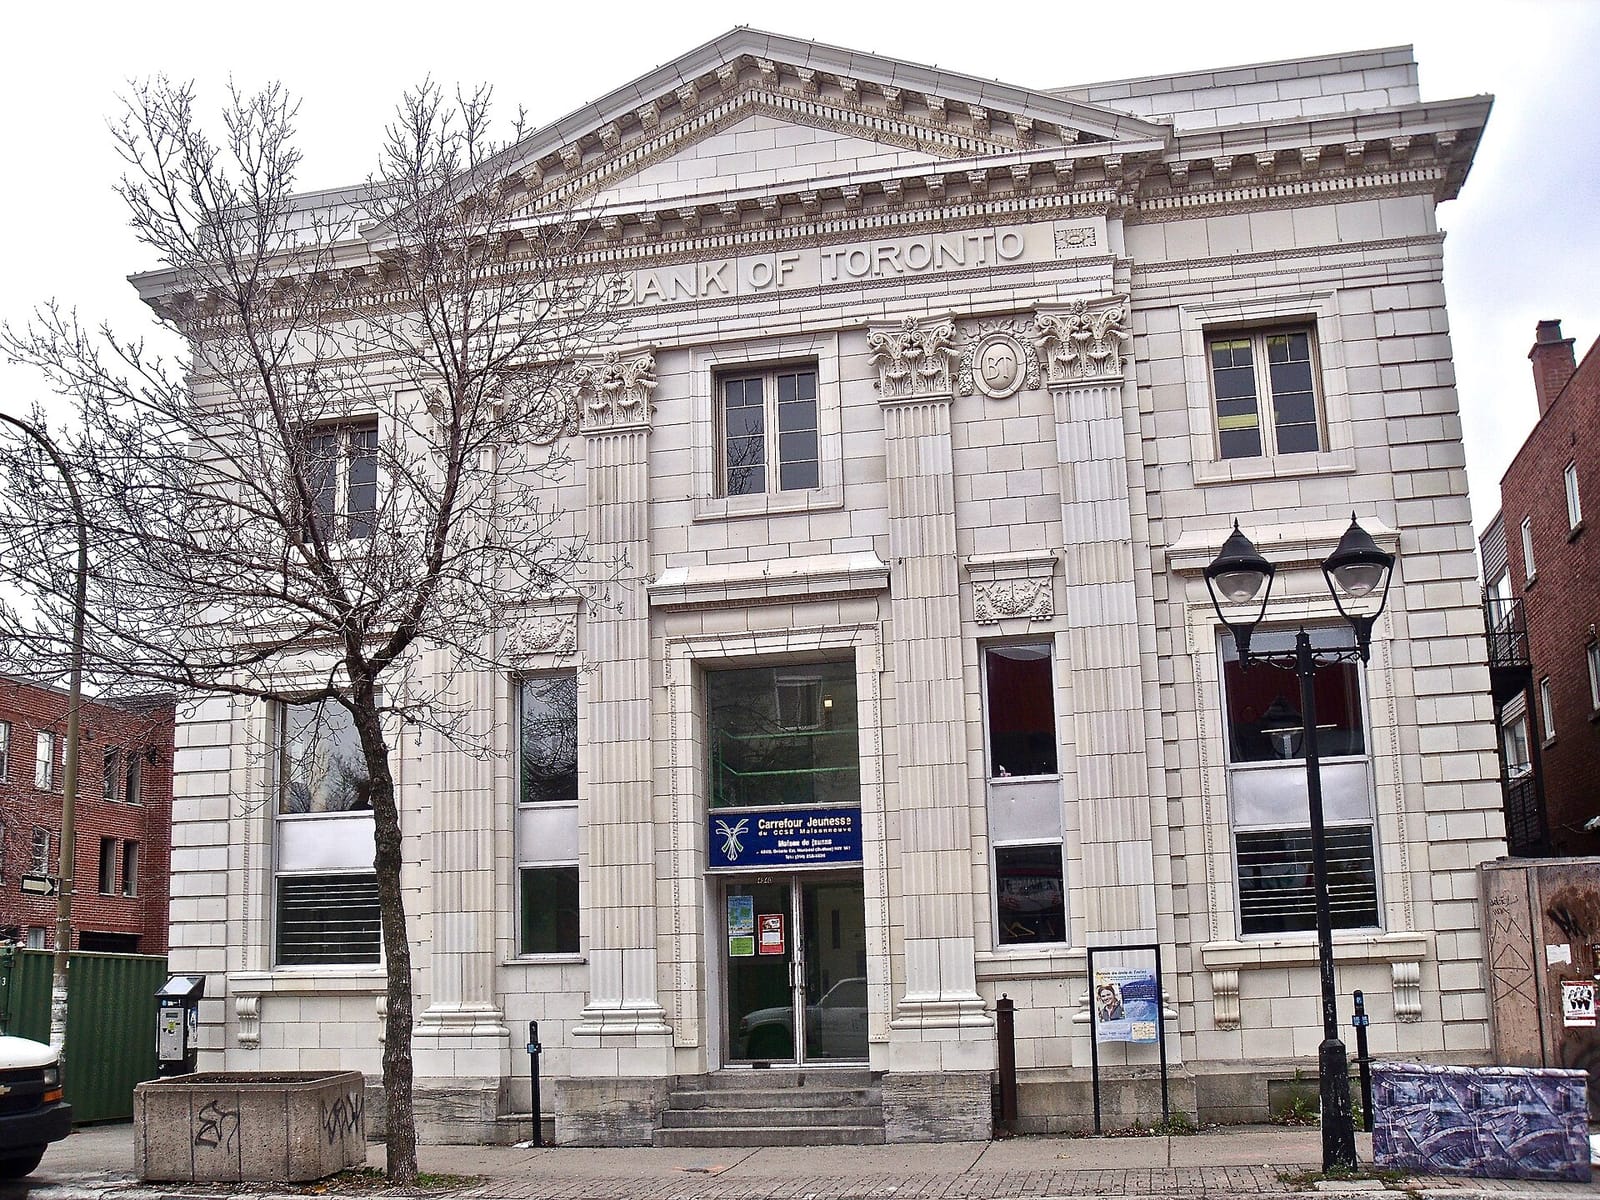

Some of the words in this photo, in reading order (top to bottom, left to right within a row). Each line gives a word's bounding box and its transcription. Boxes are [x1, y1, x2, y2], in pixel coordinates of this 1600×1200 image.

[503, 277, 587, 320] HE
[607, 262, 729, 306] BANK
[749, 253, 799, 288] OF
[821, 233, 1025, 280] TORONTO
[758, 818, 803, 829] Carrefour
[807, 816, 852, 827] Jeunesse
